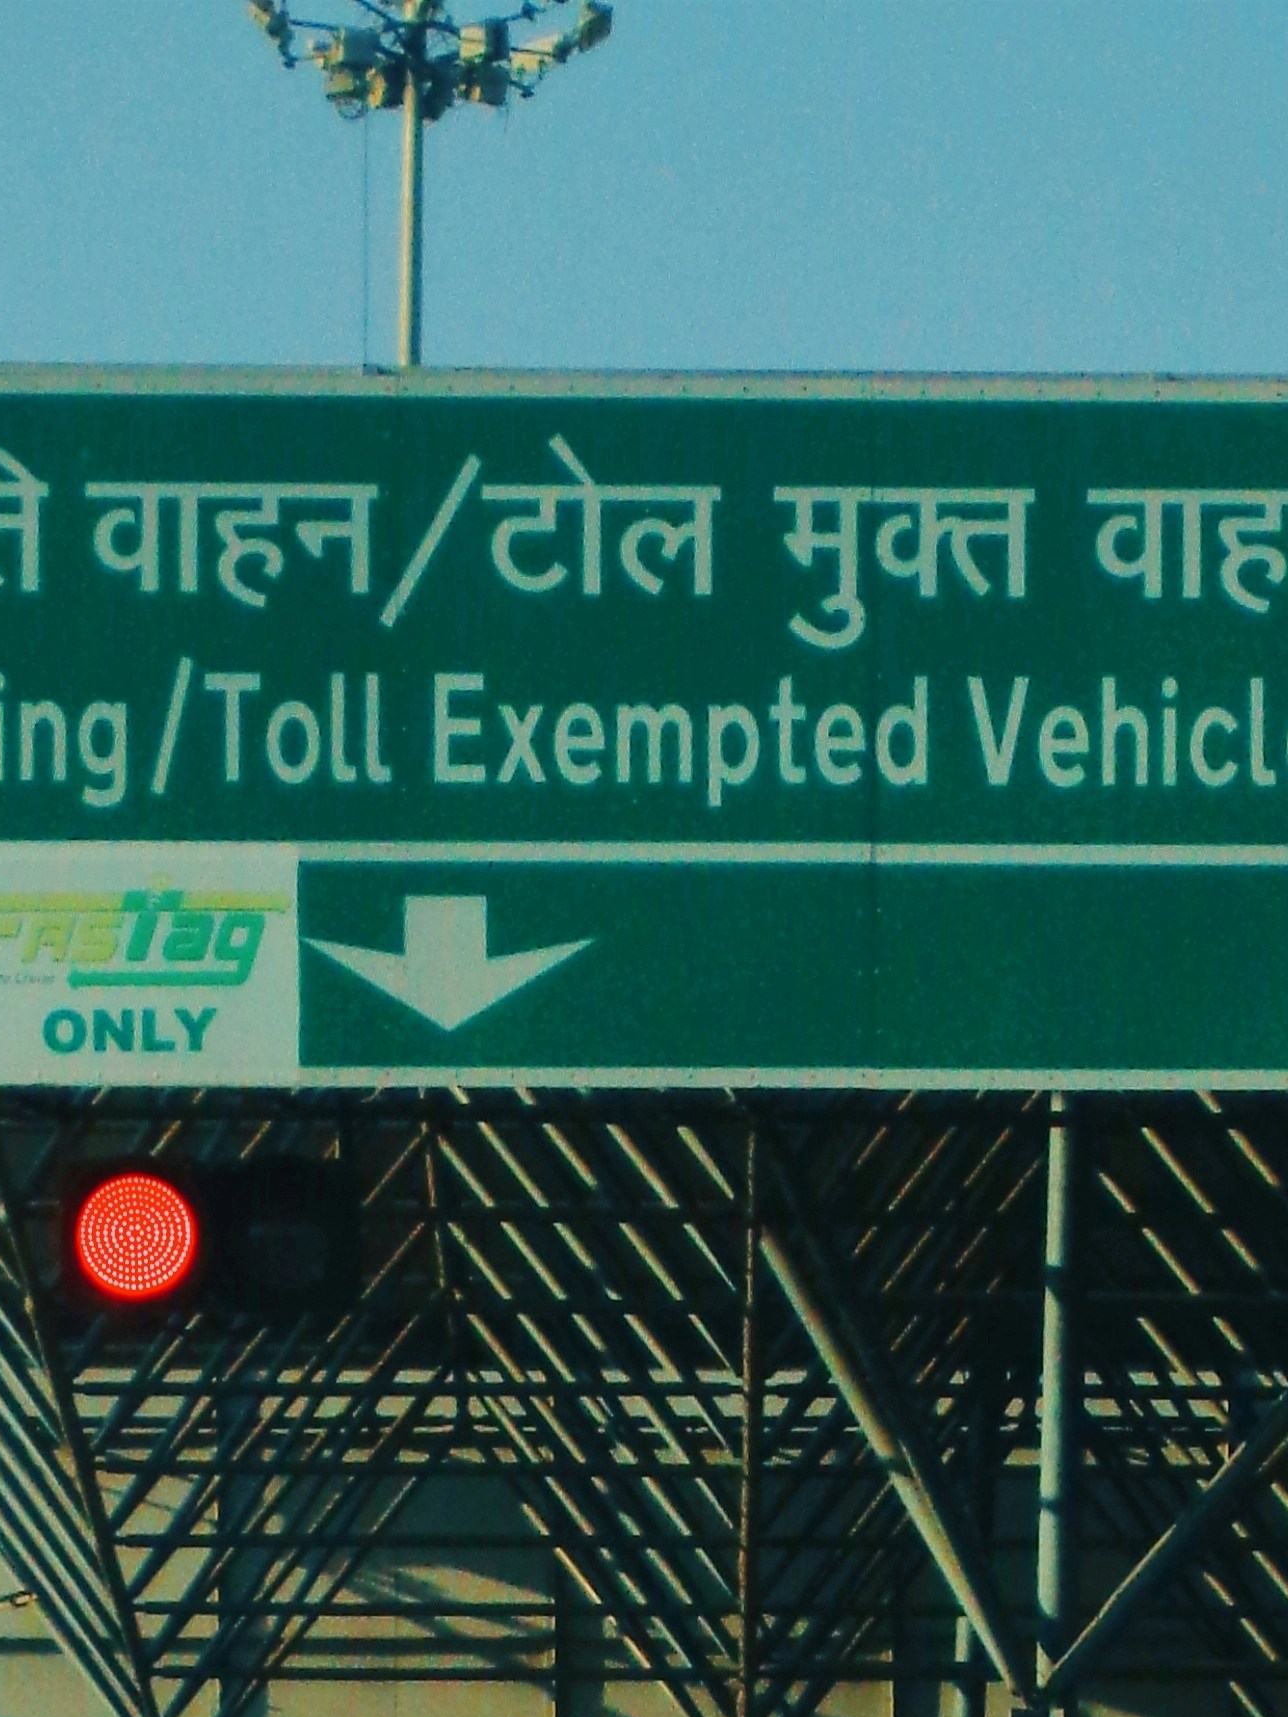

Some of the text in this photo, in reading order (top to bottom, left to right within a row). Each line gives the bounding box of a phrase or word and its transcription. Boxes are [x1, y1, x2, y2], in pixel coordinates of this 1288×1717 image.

[772, 485, 1036, 651] मुक्त
[432, 672, 929, 808] Exempted
[41, 1006, 218, 1054] ONLY
